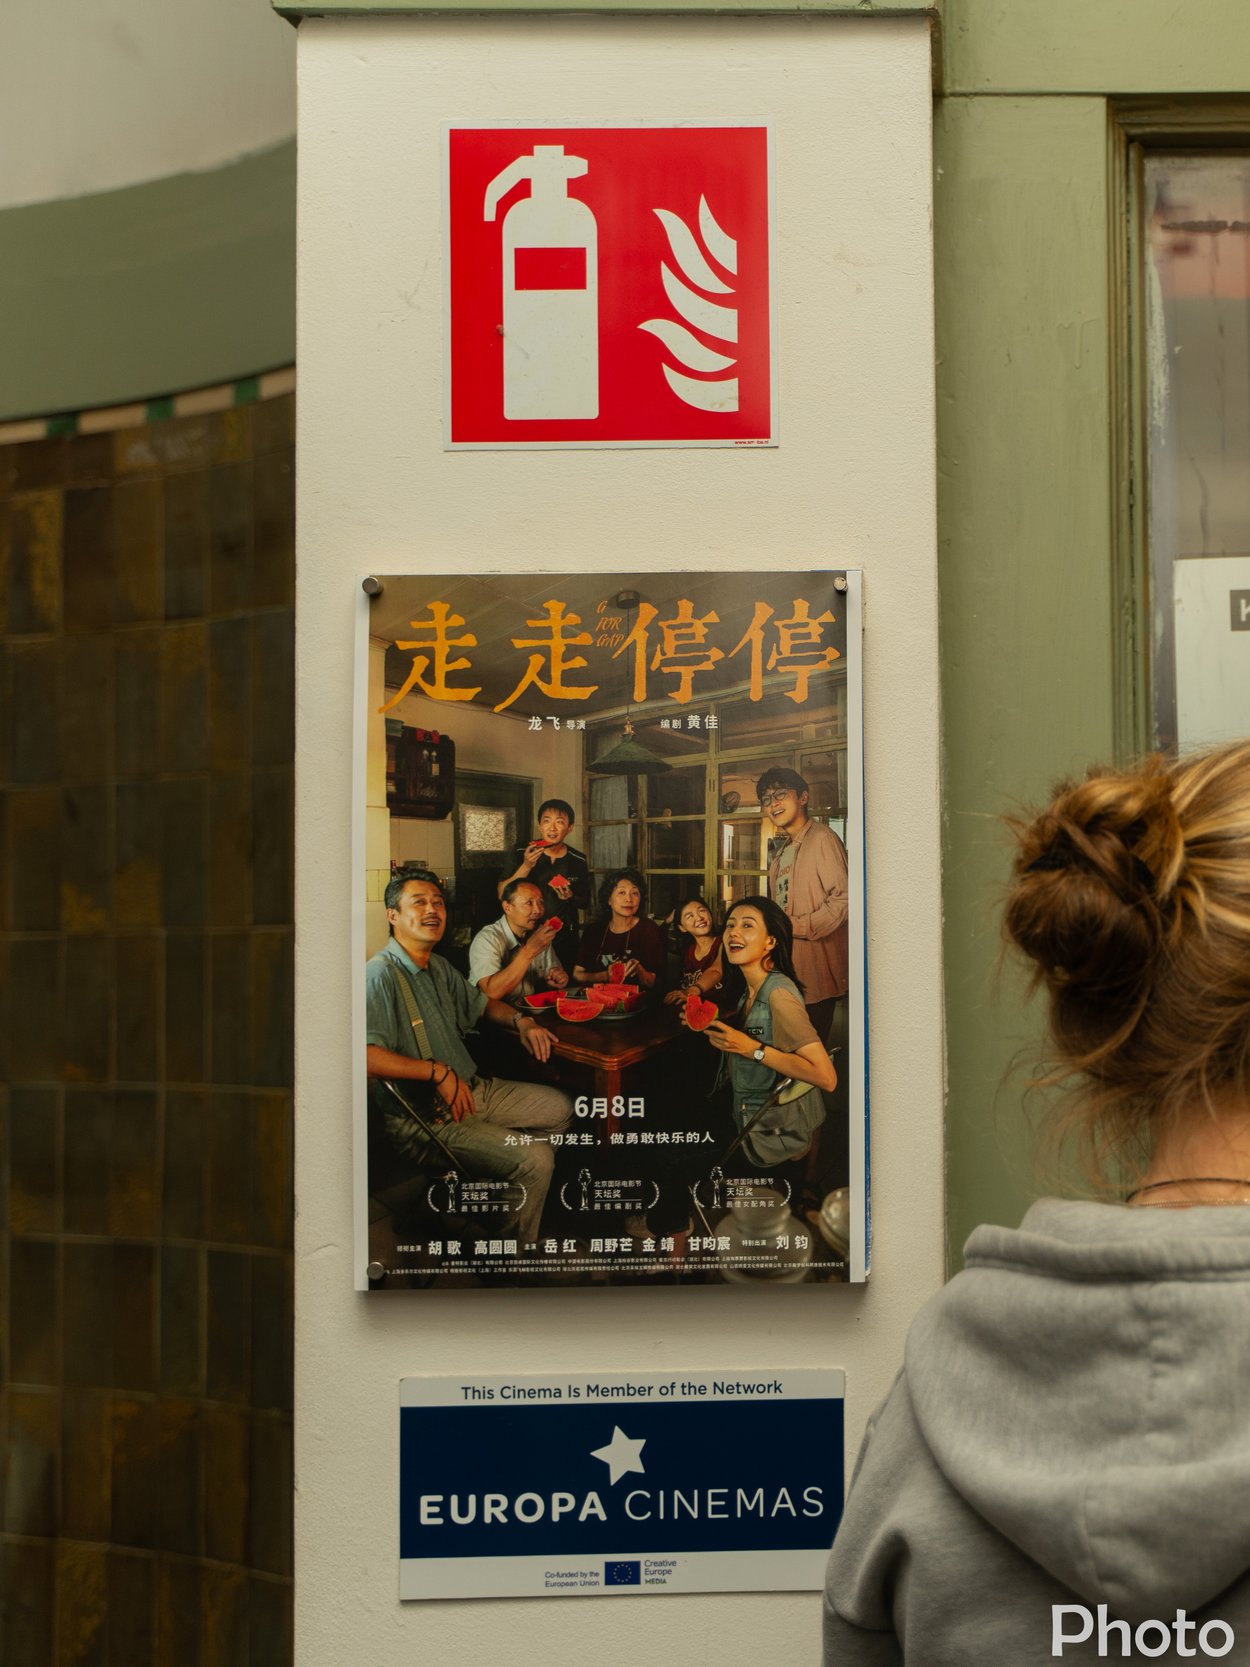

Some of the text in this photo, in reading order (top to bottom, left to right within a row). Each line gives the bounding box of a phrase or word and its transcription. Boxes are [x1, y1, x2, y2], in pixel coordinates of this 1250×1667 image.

[596, 633, 625, 648] GAP
[378, 599, 842, 713] 走走停停
[528, 716, 586, 731] 龙飞 导演
[660, 715, 719, 730] 编剧 黄佳
[574, 1095, 645, 1119] 6月8日
[504, 1131, 715, 1147] 允许一切发生，做勇敢快乐的人
[461, 1191, 489, 1200] 天坛奖
[594, 1189, 622, 1198] 天坛奖
[726, 1187, 754, 1196] 天坛奖
[428, 1240, 462, 1256] 胡歌
[474, 1239, 518, 1255] 高圆圆
[544, 1239, 577, 1254] 岳红
[590, 1237, 633, 1253] 周野芒
[642, 1236, 675, 1251] 金靖
[776, 1235, 809, 1250] 刘钧
[461, 1379, 783, 1400] This Cinema Is Member of the Network
[419, 1486, 825, 1525] EUROPA CINEMAS
[644, 1559, 677, 1568] Creative
[544, 1571, 578, 1579] Co-funded
[579, 1571, 588, 1579] by
[644, 1568, 673, 1577] Europe
[545, 1579, 600, 1588] European Union
